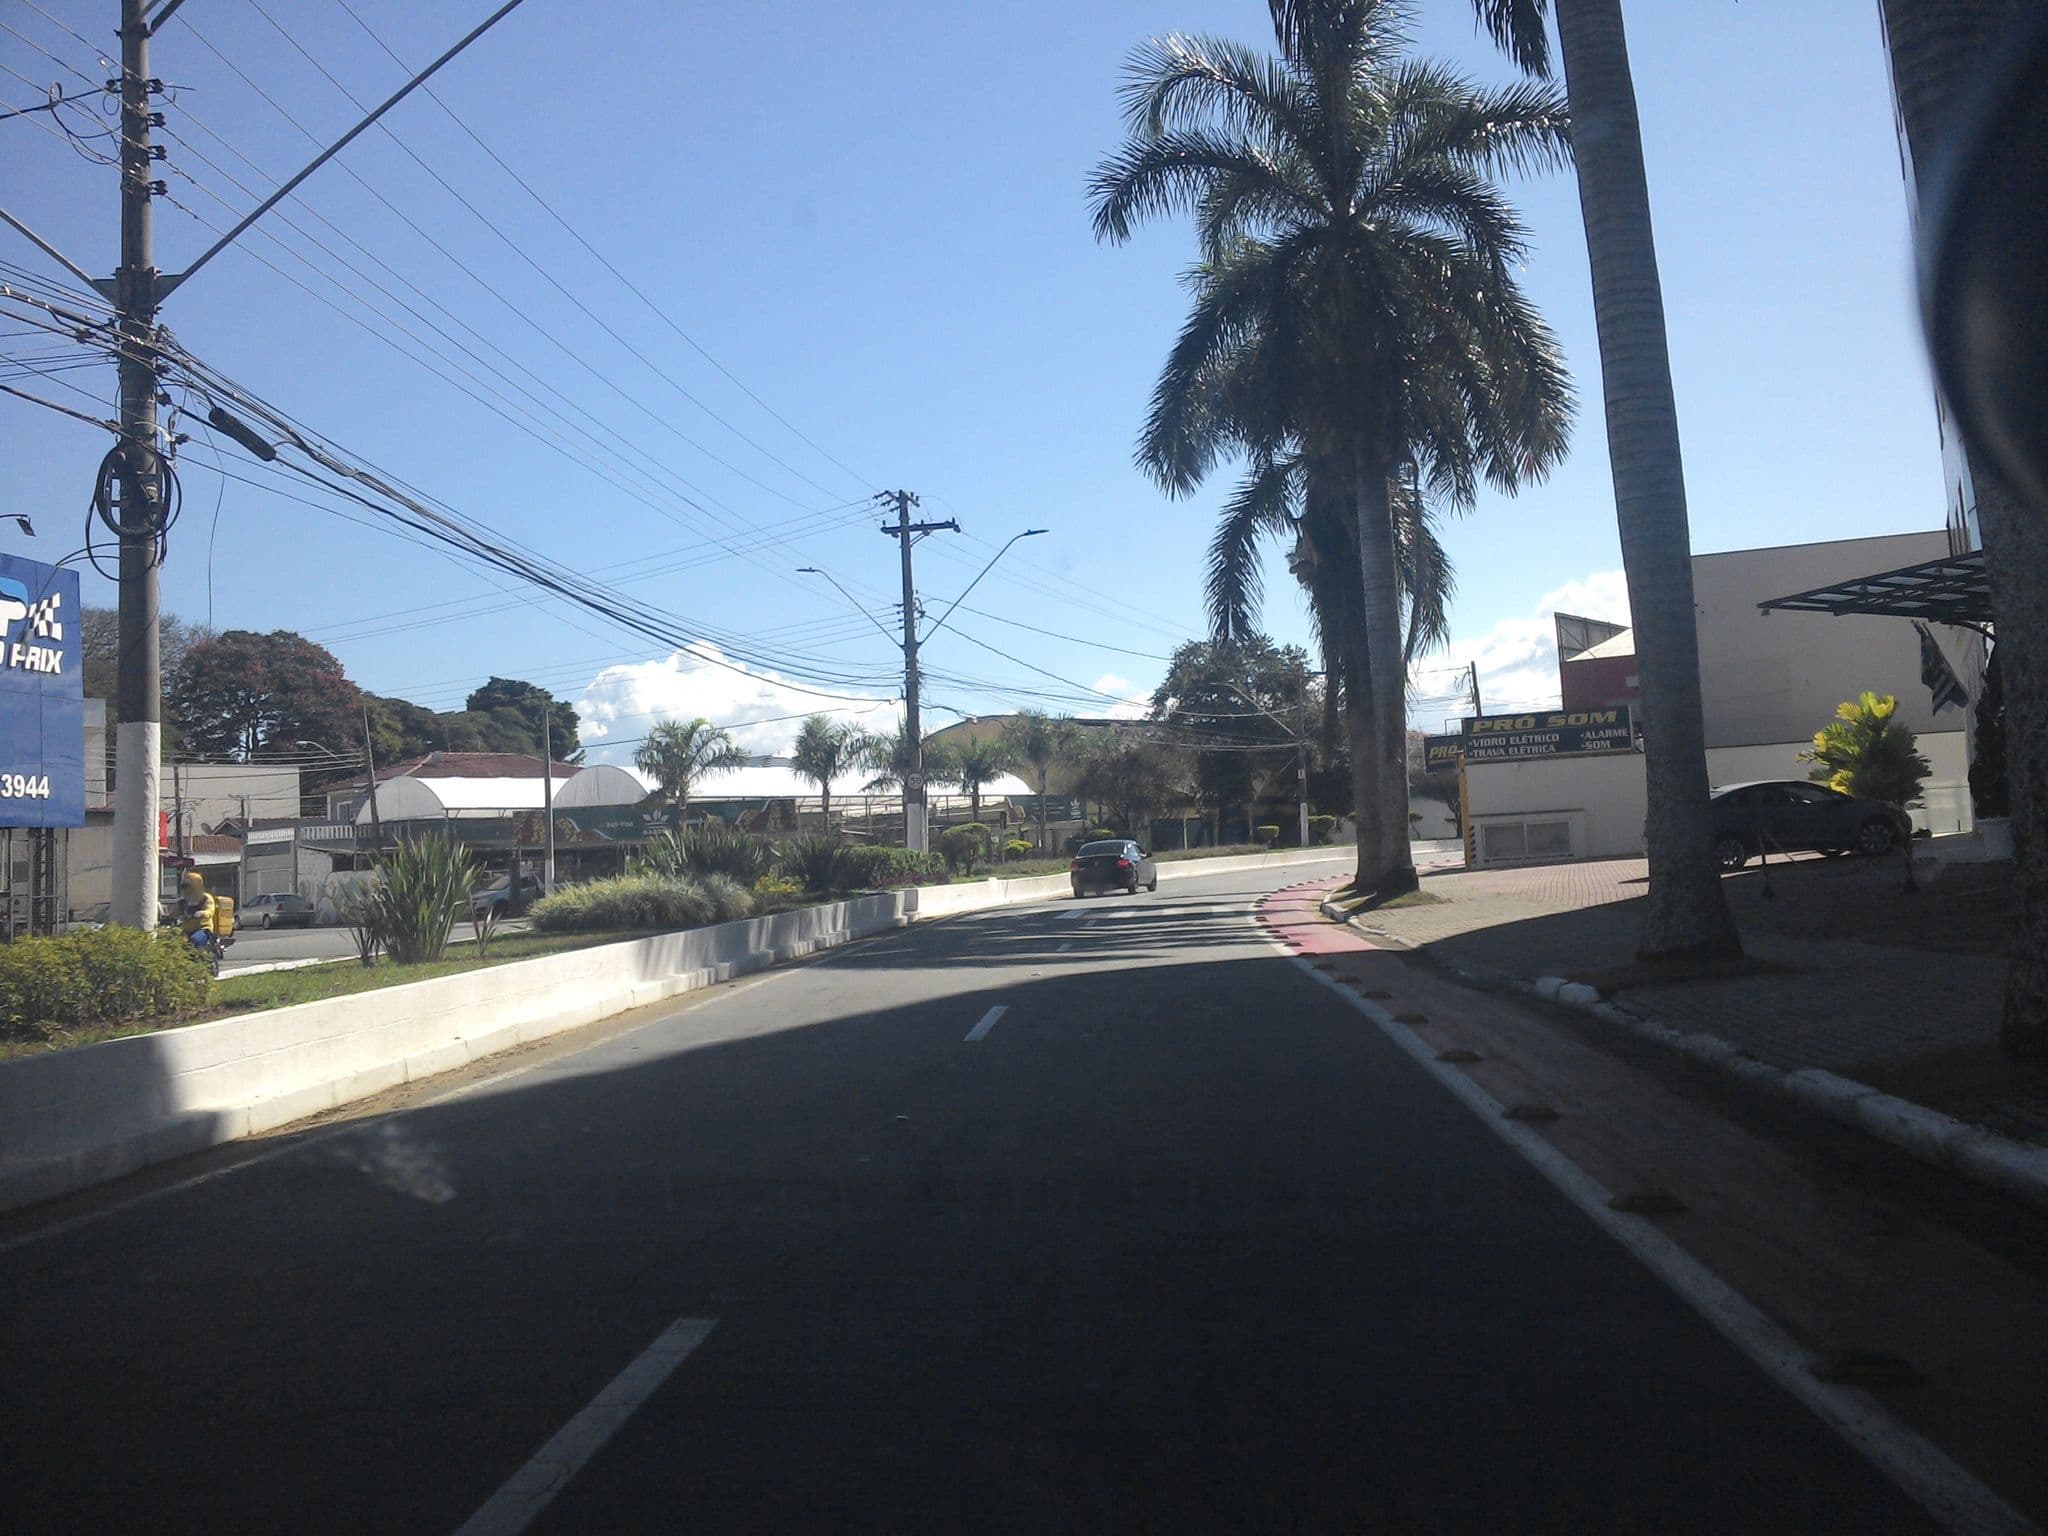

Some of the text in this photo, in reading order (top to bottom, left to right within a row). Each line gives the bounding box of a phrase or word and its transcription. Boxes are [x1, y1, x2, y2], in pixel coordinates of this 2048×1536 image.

[10, 642, 63, 674] PRIX
[1473, 711, 1617, 732] PRÓ SOM
[1472, 733, 1559, 747] VIDRO ELÉTRICO
[1584, 728, 1629, 738] ALARME
[1473, 745, 1556, 758] TRAVA ELÉTRICA
[1585, 740, 1610, 750] SOM
[1, 773, 50, 799] 3944
